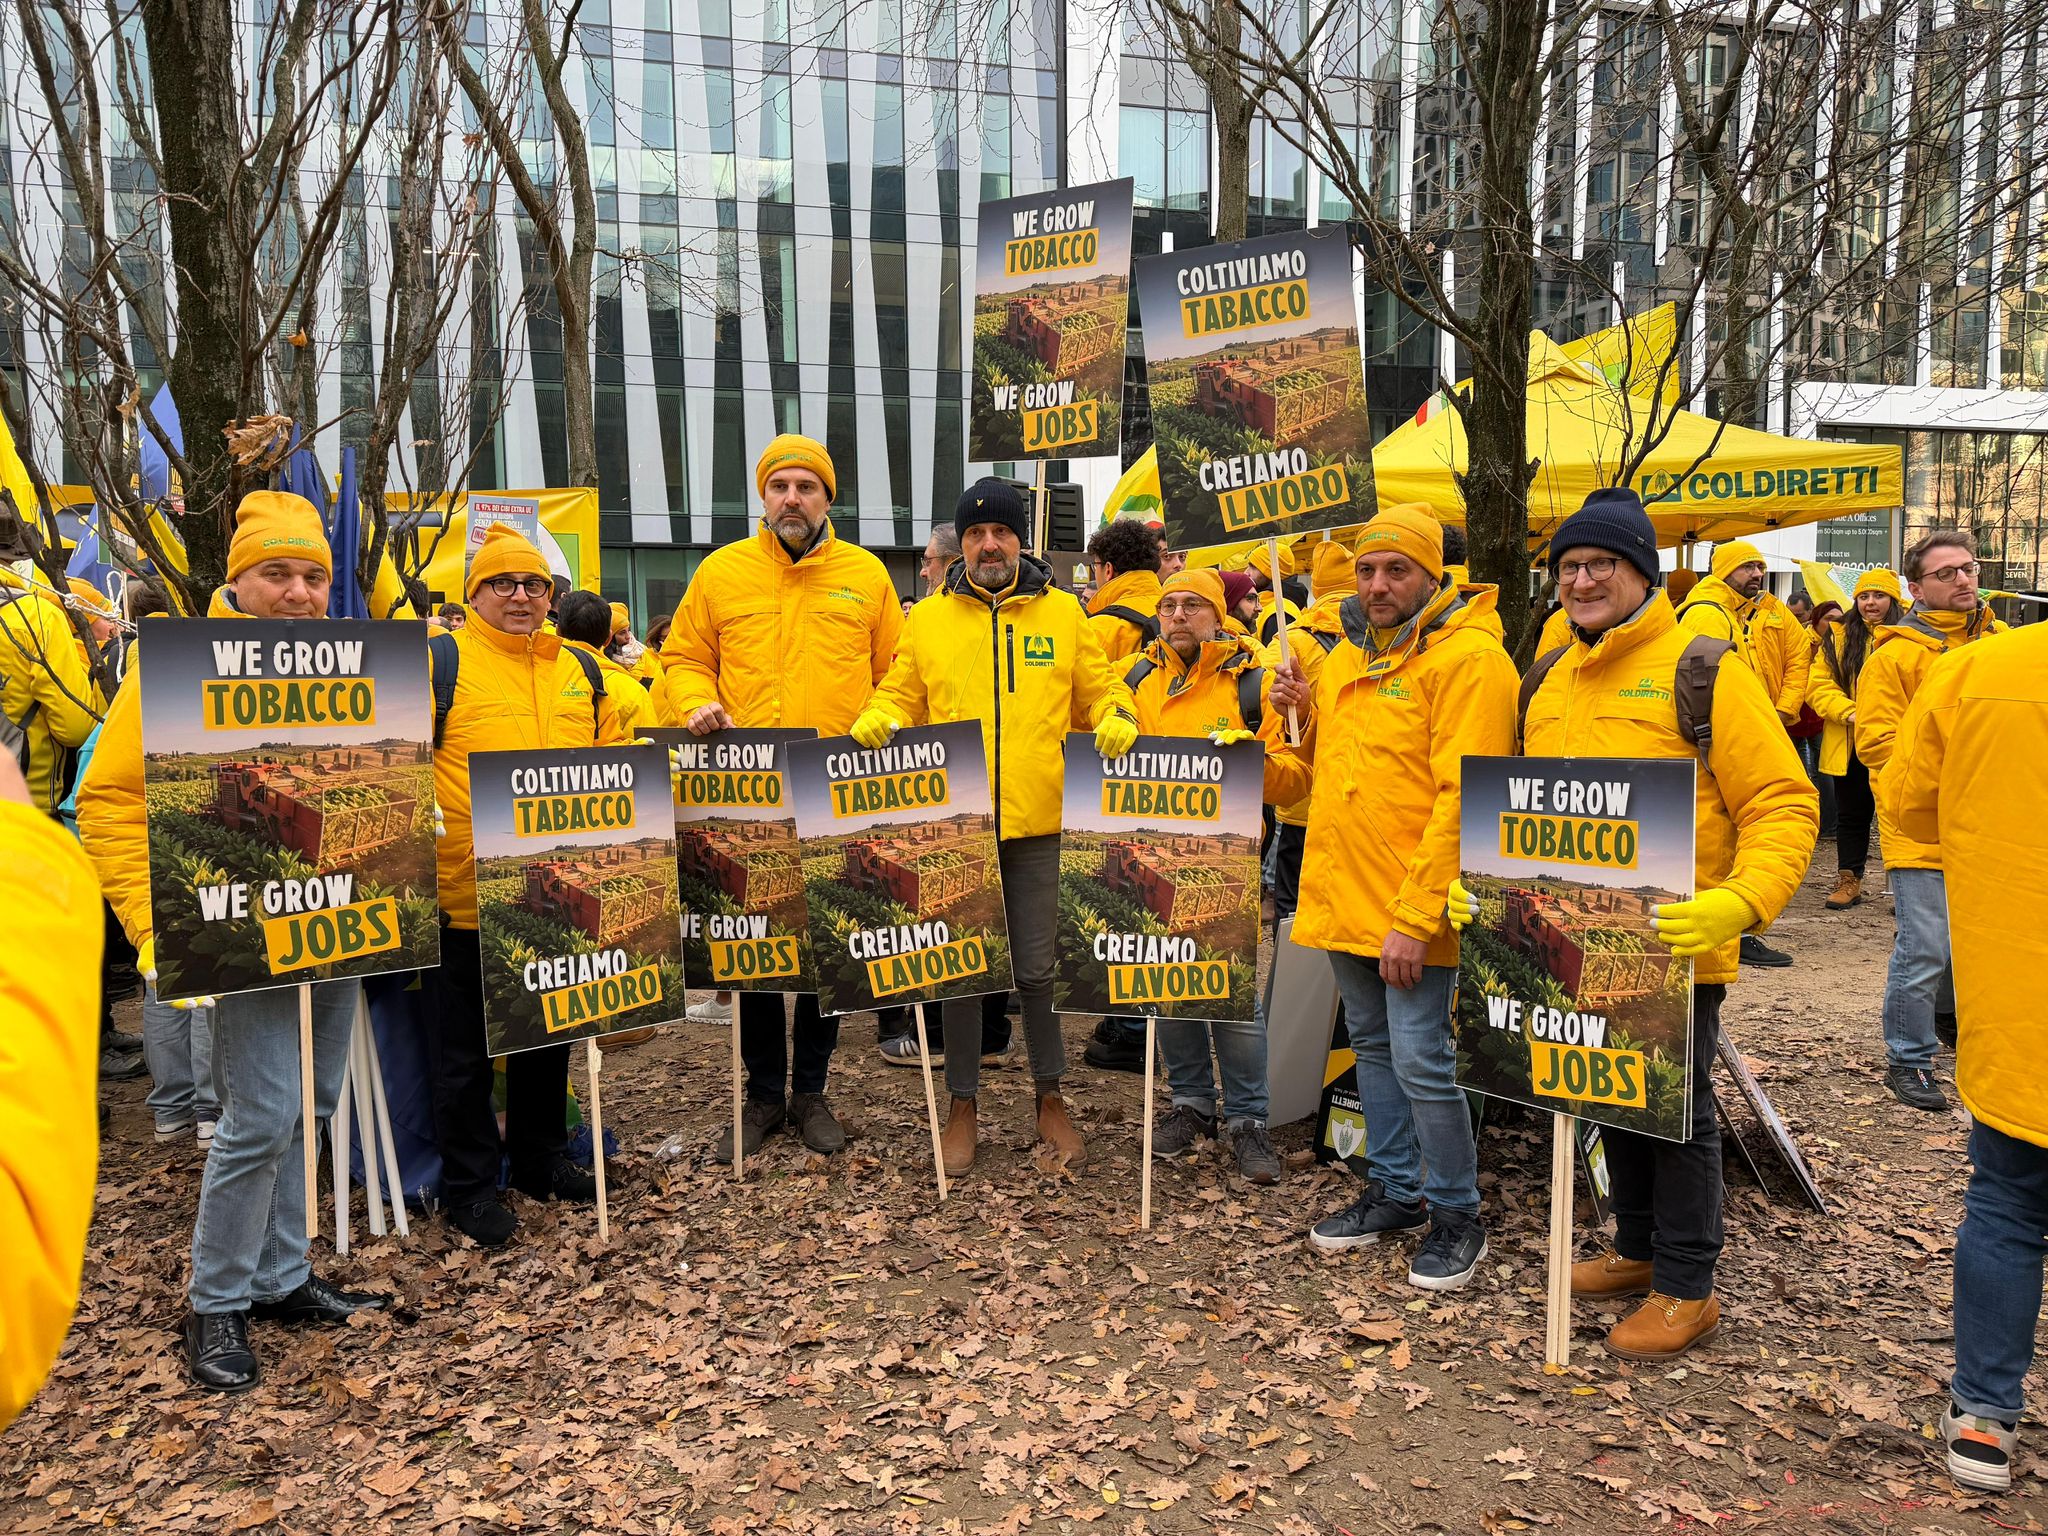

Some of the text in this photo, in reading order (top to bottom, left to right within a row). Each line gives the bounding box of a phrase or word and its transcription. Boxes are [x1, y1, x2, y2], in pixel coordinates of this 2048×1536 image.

[1012, 200, 1095, 238] WE GROW
[1008, 232, 1096, 273] TOBACCO
[1177, 250, 1306, 296] COLTIVIAMO
[1185, 284, 1306, 334] TABACCO
[994, 380, 1074, 411] WE GROW
[1028, 404, 1092, 446] JOBS
[1200, 447, 1308, 492] CREIAMO
[1688, 466, 1878, 500] COLDIRETTI
[1226, 468, 1343, 526] LAVORO
[212, 641, 363, 676] WE GROW
[208, 682, 372, 726] TOBACCO
[1619, 688, 1670, 700] COLDIRETTI
[678, 744, 774, 770] WE GROW
[826, 741, 946, 779] COLTIVIAMO
[1102, 752, 1223, 782] COLTIVIAMO
[511, 762, 634, 795] COLTIVIAMO
[680, 774, 780, 804] TOBACCO
[833, 771, 946, 815] TABACCO
[1508, 778, 1630, 816] WE GROW
[518, 794, 632, 834] TABACCO
[1106, 782, 1218, 818] TABACCO
[1502, 816, 1635, 866] TOBACCO
[198, 874, 352, 922] WE GROW
[278, 903, 392, 966] JOBS
[710, 914, 768, 940] GROW
[848, 920, 949, 960] CREIAMO
[719, 940, 794, 976] JOBS
[872, 941, 982, 994] LAVORO
[1094, 932, 1196, 964] CREIAMO
[524, 948, 628, 992] CREIAMO
[1114, 964, 1225, 1000] LAVORO
[548, 969, 656, 1028] LAVORO
[1487, 996, 1606, 1048] WE GROW
[1538, 1048, 1638, 1100] JOBS
[1332, 1094, 1363, 1112] LDIRETTI
